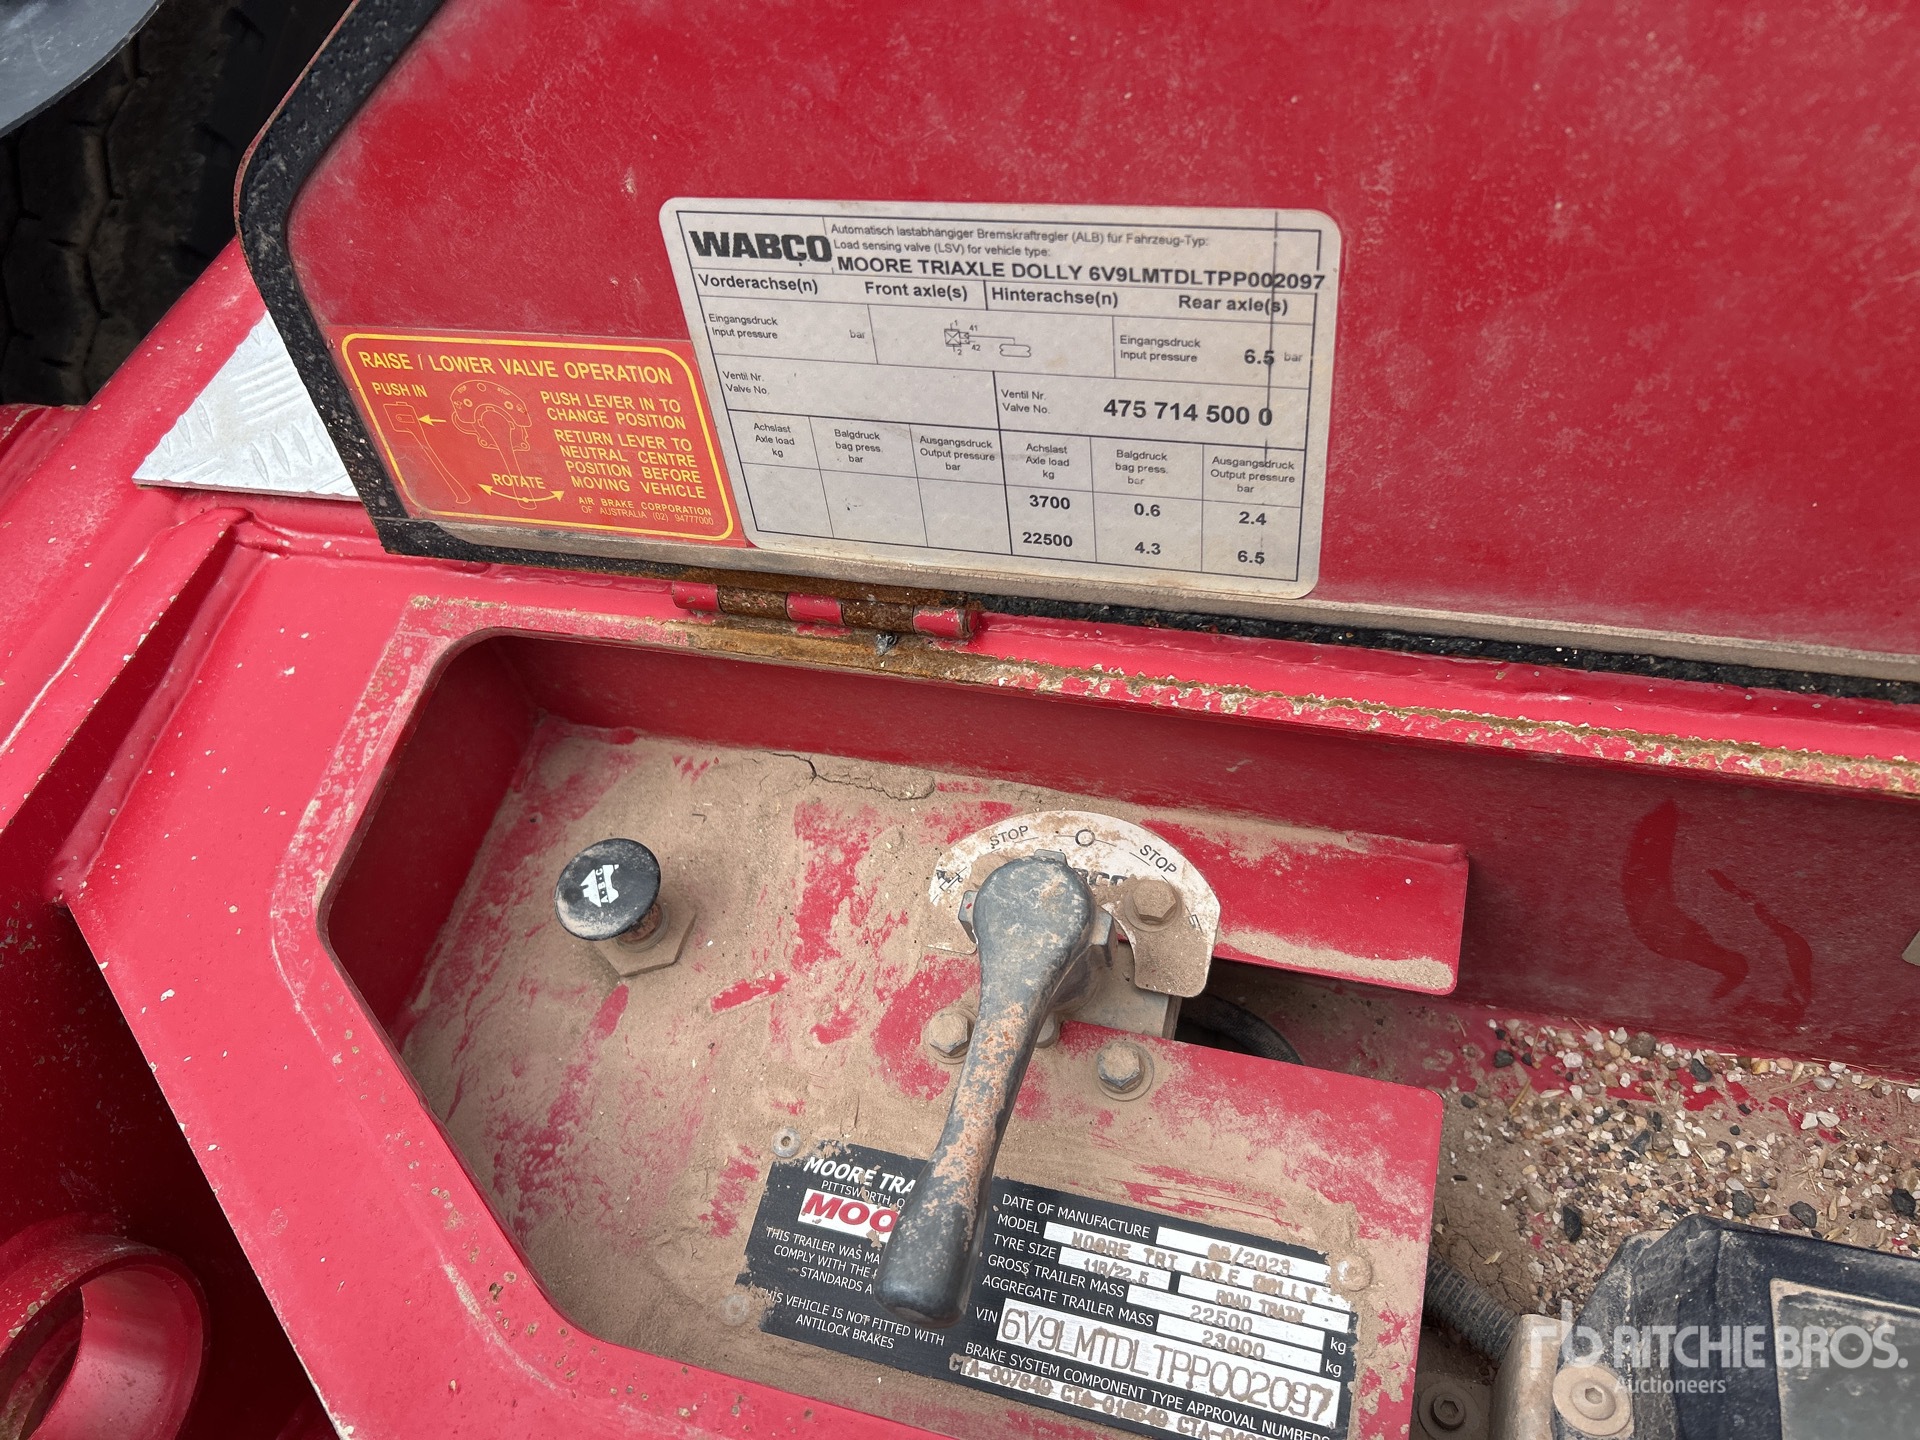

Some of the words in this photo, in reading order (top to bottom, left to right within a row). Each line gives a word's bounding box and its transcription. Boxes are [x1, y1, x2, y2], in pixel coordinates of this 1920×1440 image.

[831, 224, 894, 237] Automatisch
[896, 225, 974, 240] lastabhängiger
[977, 227, 1068, 243] Bremskraftregler
[1071, 231, 1104, 245] (ALB)
[1126, 232, 1209, 248] Fahrzeug-Typ:
[689, 230, 832, 264] WABCO
[833, 240, 860, 250] Load
[861, 241, 901, 253] sensing
[904, 243, 931, 253] valve
[934, 243, 965, 255] (LSV)
[967, 244, 982, 254] for
[985, 245, 1021, 256] vehicle
[1024, 247, 1051, 259] type:
[837, 256, 913, 274] MOORE
[917, 259, 1005, 278] TRIAXLE
[1011, 263, 1083, 281] DOLLY
[1088, 265, 1326, 290] 6V9LMTDLTPP002097
[698, 273, 819, 295] Vorderachse(n)
[864, 281, 910, 297] Front
[914, 284, 969, 301] axle(s)
[991, 287, 1119, 307] Hinterachse(n)
[1178, 294, 1221, 312] Rear
[1226, 296, 1289, 316] axle(s)
[708, 313, 778, 327] Eingangsdruck
[711, 327, 736, 340] Input
[737, 329, 778, 342] pressure
[849, 329, 866, 340] bar
[1119, 335, 1201, 349] Eingangsdruck
[1120, 350, 1147, 363] Input
[1149, 352, 1198, 366] pressure
[1244, 349, 1275, 366] 6.5
[1284, 352, 1303, 363] bar
[358, 351, 414, 370] RAISE
[428, 355, 496, 375] LOWER
[498, 357, 559, 379] VALVE
[563, 361, 673, 384] OPERATION
[722, 370, 749, 382] Ventil
[371, 381, 411, 397] PUSH
[412, 384, 428, 397] IN
[725, 383, 751, 395] Valve
[1001, 389, 1029, 400] Ventil
[1031, 391, 1047, 401] Nr.
[540, 390, 581, 406] PUSH
[585, 394, 636, 410] LEVER
[639, 397, 656, 411] IN
[659, 399, 681, 413] TO
[1002, 402, 1031, 413] Valve
[1033, 404, 1050, 414] No.
[546, 407, 609, 424] CHANGE
[616, 412, 686, 430] POSITION
[1103, 399, 1147, 419] 475
[1153, 402, 1198, 421] 714
[1205, 405, 1250, 425] 500
[1258, 407, 1273, 426] 0
[753, 422, 792, 434] Achslast
[834, 429, 881, 441] Balgdruck
[553, 429, 614, 446] RETURN
[617, 434, 666, 450] LEVER
[670, 437, 693, 452] TO
[755, 435, 773, 445] Axle
[774, 436, 796, 446] load
[835, 441, 852, 453] bag
[919, 435, 993, 450] Ausgangsdruck
[1026, 443, 1068, 455] Achslast
[558, 445, 628, 462] NEUTRAL
[637, 451, 698, 468] CENTRE
[772, 448, 784, 459] kg
[849, 454, 863, 464] bar
[920, 448, 951, 461] Output
[953, 451, 996, 463] pressure
[1025, 455, 1046, 466] Axle
[1048, 457, 1070, 468] load
[1116, 449, 1168, 463] Balgdruck
[564, 461, 632, 477] POSITION
[641, 467, 702, 484] BEFORE
[945, 462, 961, 472] bar
[1115, 462, 1135, 474] bag
[1137, 464, 1169, 476] press.
[1211, 456, 1295, 471] Ausgangsdruck
[491, 473, 546, 490] ROTATE
[1042, 469, 1055, 480] kg
[1127, 476, 1145, 486] bar
[1210, 469, 1246, 481] Output
[1248, 471, 1296, 484] pressure
[570, 476, 631, 492] MOVING
[640, 481, 706, 499] VEHICLE
[1236, 483, 1254, 494] bar
[578, 497, 595, 506] AIR
[601, 499, 634, 509] BRAKE
[640, 501, 712, 516] CORPORATION
[581, 505, 593, 514] OF
[600, 508, 647, 519] AUSTRALIA
[653, 510, 669, 522] (02)
[1029, 494, 1071, 510] 3700
[1133, 502, 1161, 518] 0.6
[1238, 511, 1267, 526] 2.4
[1022, 531, 1073, 548] 22500
[1134, 541, 1162, 556] 4.3
[1237, 549, 1266, 565] 6.5
[989, 825, 1029, 848] STOP
[1139, 844, 1177, 875] STOP
[803, 1156, 877, 1186] MOORE
[1002, 1194, 1035, 1211] DATE
[1037, 1202, 1056, 1215] OF
[1057, 1207, 1151, 1239] MANUFACTURE
[766, 1226, 790, 1243] THIS
[793, 1233, 836, 1254] TRAILER
[838, 1245, 863, 1260] WAS
[993, 1233, 1025, 1252] TYRE
[1027, 1242, 1057, 1259] SIZE
[997, 1213, 1040, 1234] MODEL
[1071, 1231, 1132, 1260] MOORE
[1143, 1247, 1179, 1271] TRI
[774, 1244, 816, 1264] COMPLY
[817, 1256, 847, 1272] WITH
[849, 1263, 872, 1279] THE
[799, 1266, 862, 1292] STANDARDS
[987, 1254, 1030, 1274] GROSS
[1034, 1265, 1086, 1289] TRAILER
[1089, 1279, 1125, 1298] MASS
[1189, 1304, 1253, 1335] 22500
[1330, 1337, 1347, 1355] kg
[785, 1294, 831, 1316] VEHICLE
[831, 1306, 844, 1319] IS
[846, 1310, 870, 1326] NOT
[871, 1317, 911, 1337] FITTED
[914, 1326, 946, 1347] WITH
[982, 1274, 1058, 1303] AGGREGATE
[1061, 1293, 1114, 1318] TRAILER
[1118, 1308, 1155, 1327] MASS
[1202, 1329, 1266, 1360] 23000
[1325, 1359, 1342, 1378] kg
[795, 1314, 850, 1338] ANTILOCK
[852, 1329, 895, 1349] BRAKES
[975, 1307, 998, 1323] VIN
[1001, 1308, 1334, 1422] 6V9LMTDLTPP002097
[965, 1342, 1007, 1363] BRAKE
[1010, 1354, 1059, 1378] SYSTEM
[1063, 1368, 1147, 1400] COMPONENT
[1151, 1389, 1184, 1410] TYPE
[1186, 1400, 1258, 1431] APPROVAL
